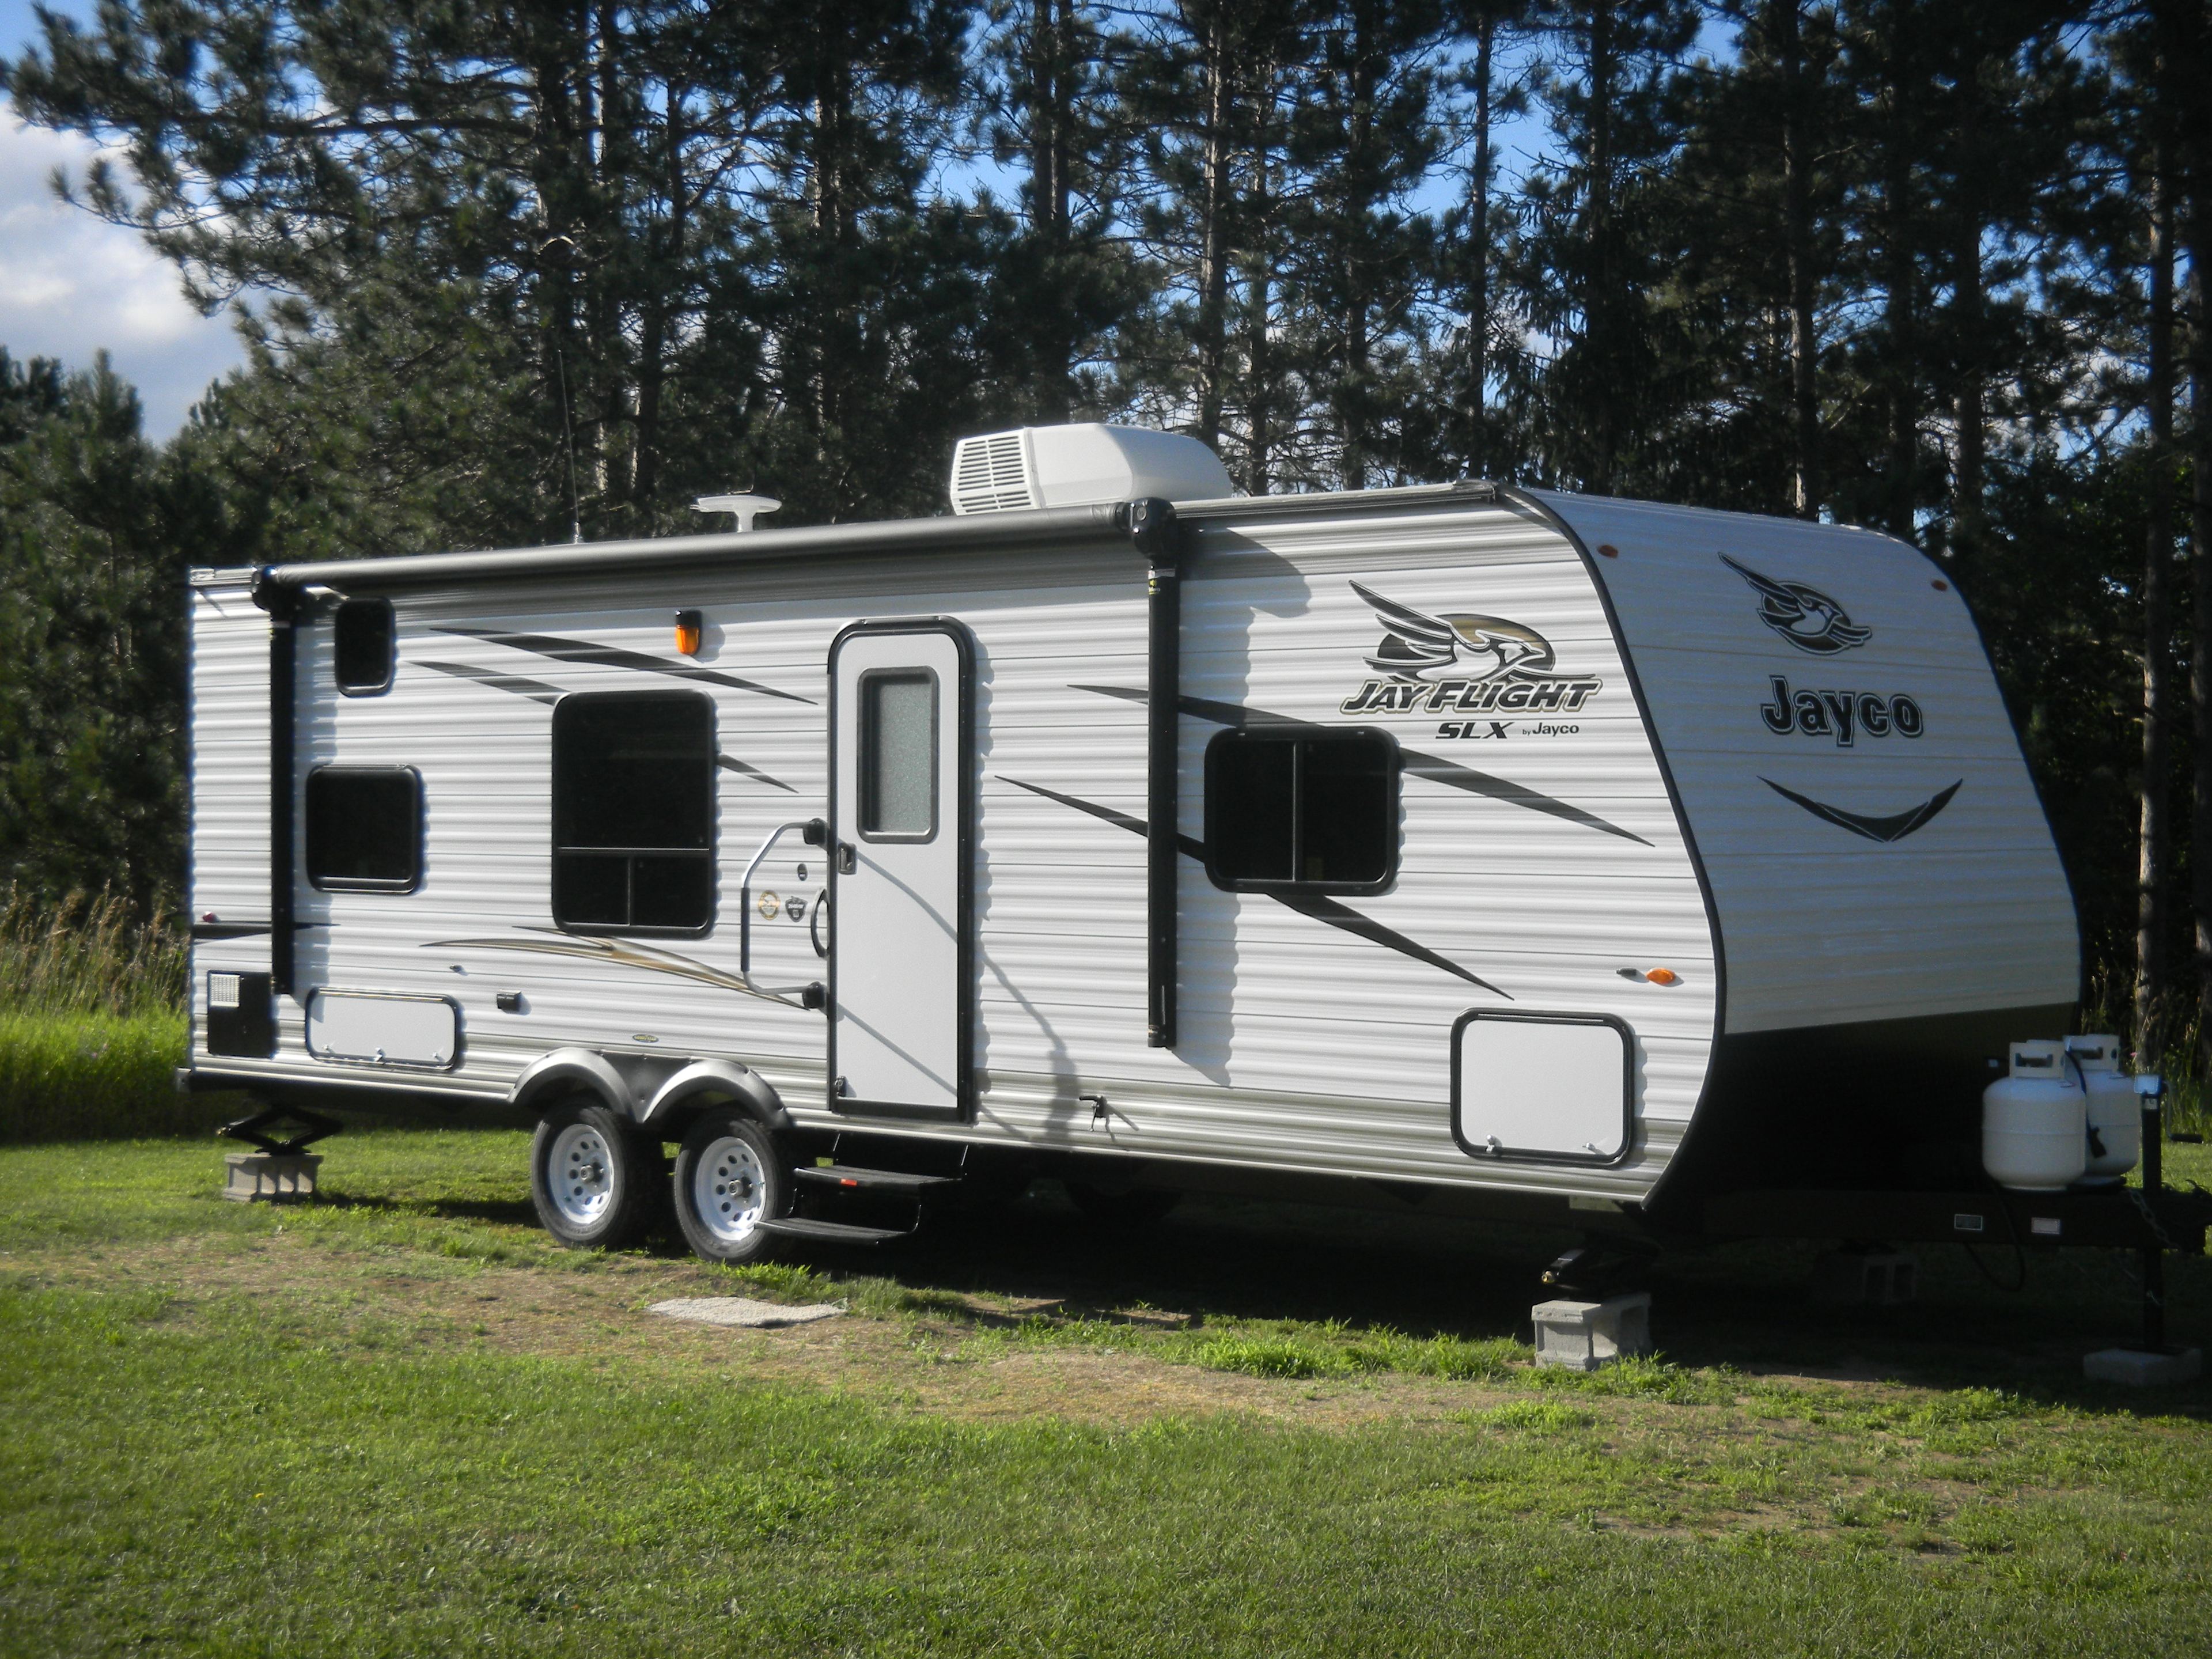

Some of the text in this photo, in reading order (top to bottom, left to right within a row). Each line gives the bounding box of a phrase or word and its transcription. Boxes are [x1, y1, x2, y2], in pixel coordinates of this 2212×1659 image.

[1435, 722, 1516, 739] SLX
[1532, 722, 1580, 737] Jayco
[1760, 675, 1924, 747] Jayco
